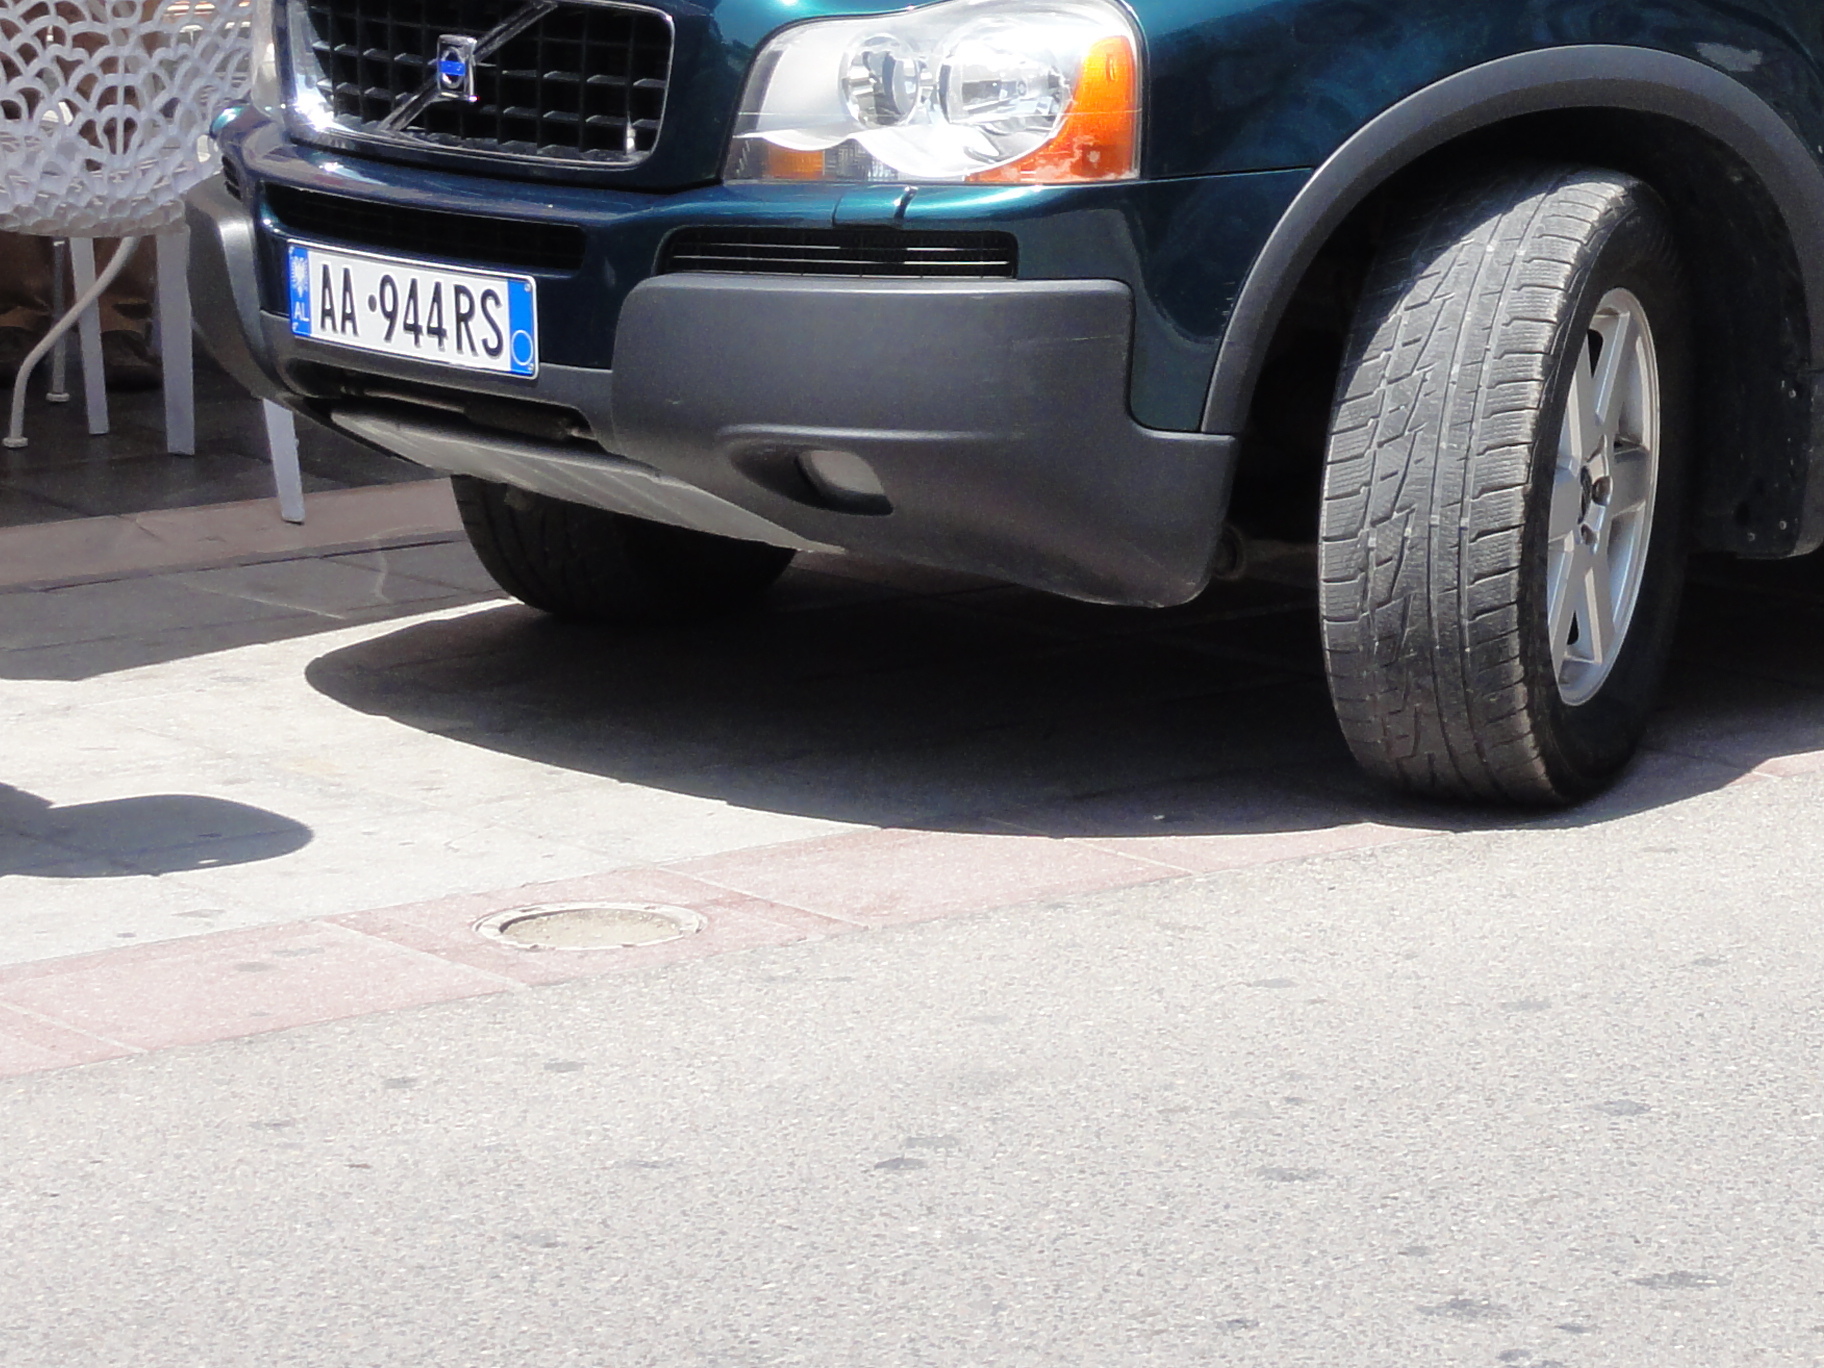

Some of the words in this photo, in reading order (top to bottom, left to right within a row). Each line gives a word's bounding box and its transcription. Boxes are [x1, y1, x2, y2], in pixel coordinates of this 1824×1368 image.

[294, 301, 310, 322] AL
[320, 263, 359, 336] AA
[379, 274, 504, 359] 944RS
